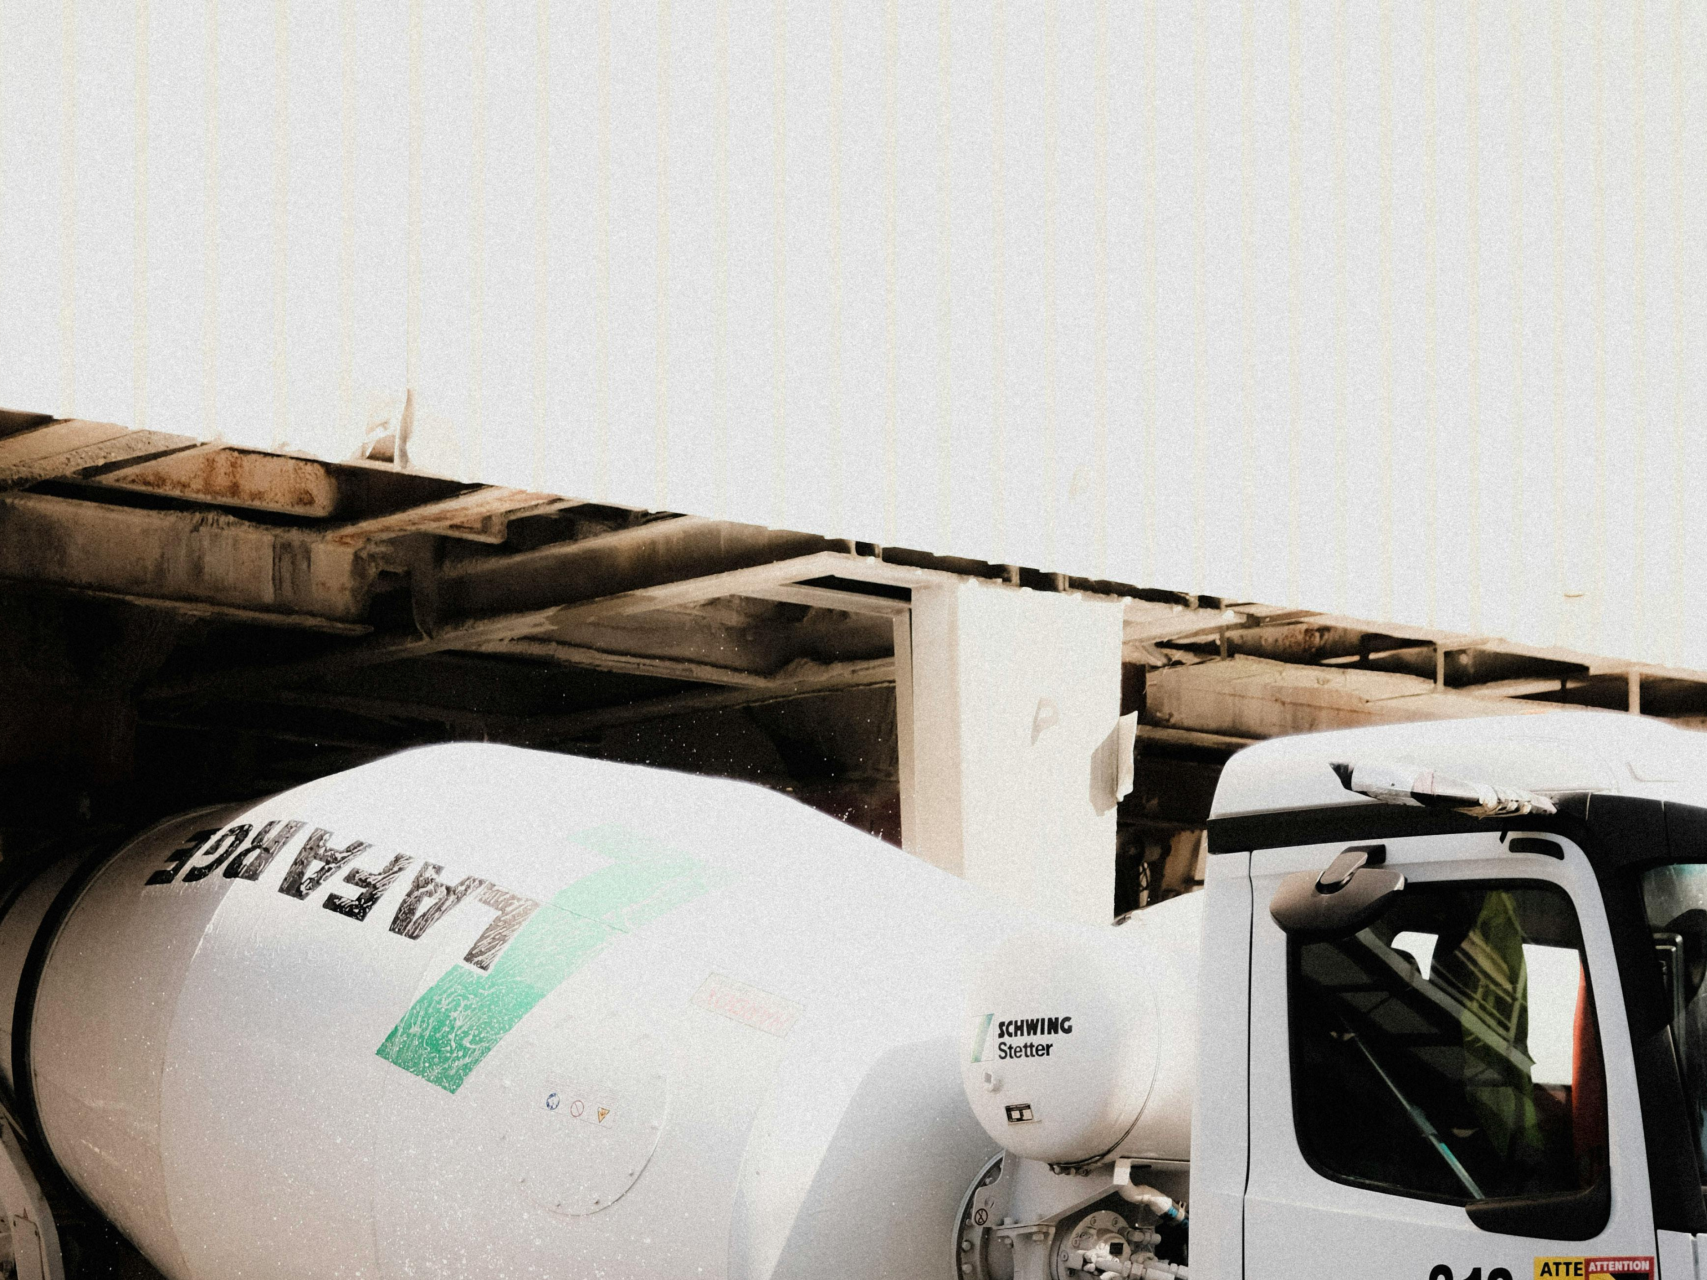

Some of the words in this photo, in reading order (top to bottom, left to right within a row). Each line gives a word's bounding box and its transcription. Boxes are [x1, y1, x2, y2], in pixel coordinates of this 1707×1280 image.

[145, 820, 540, 971] LAFARGE
[998, 1016, 1073, 1039] SCHWING
[998, 1041, 1053, 1060] Stetter
[1588, 1260, 1650, 1272] ATTENTION
